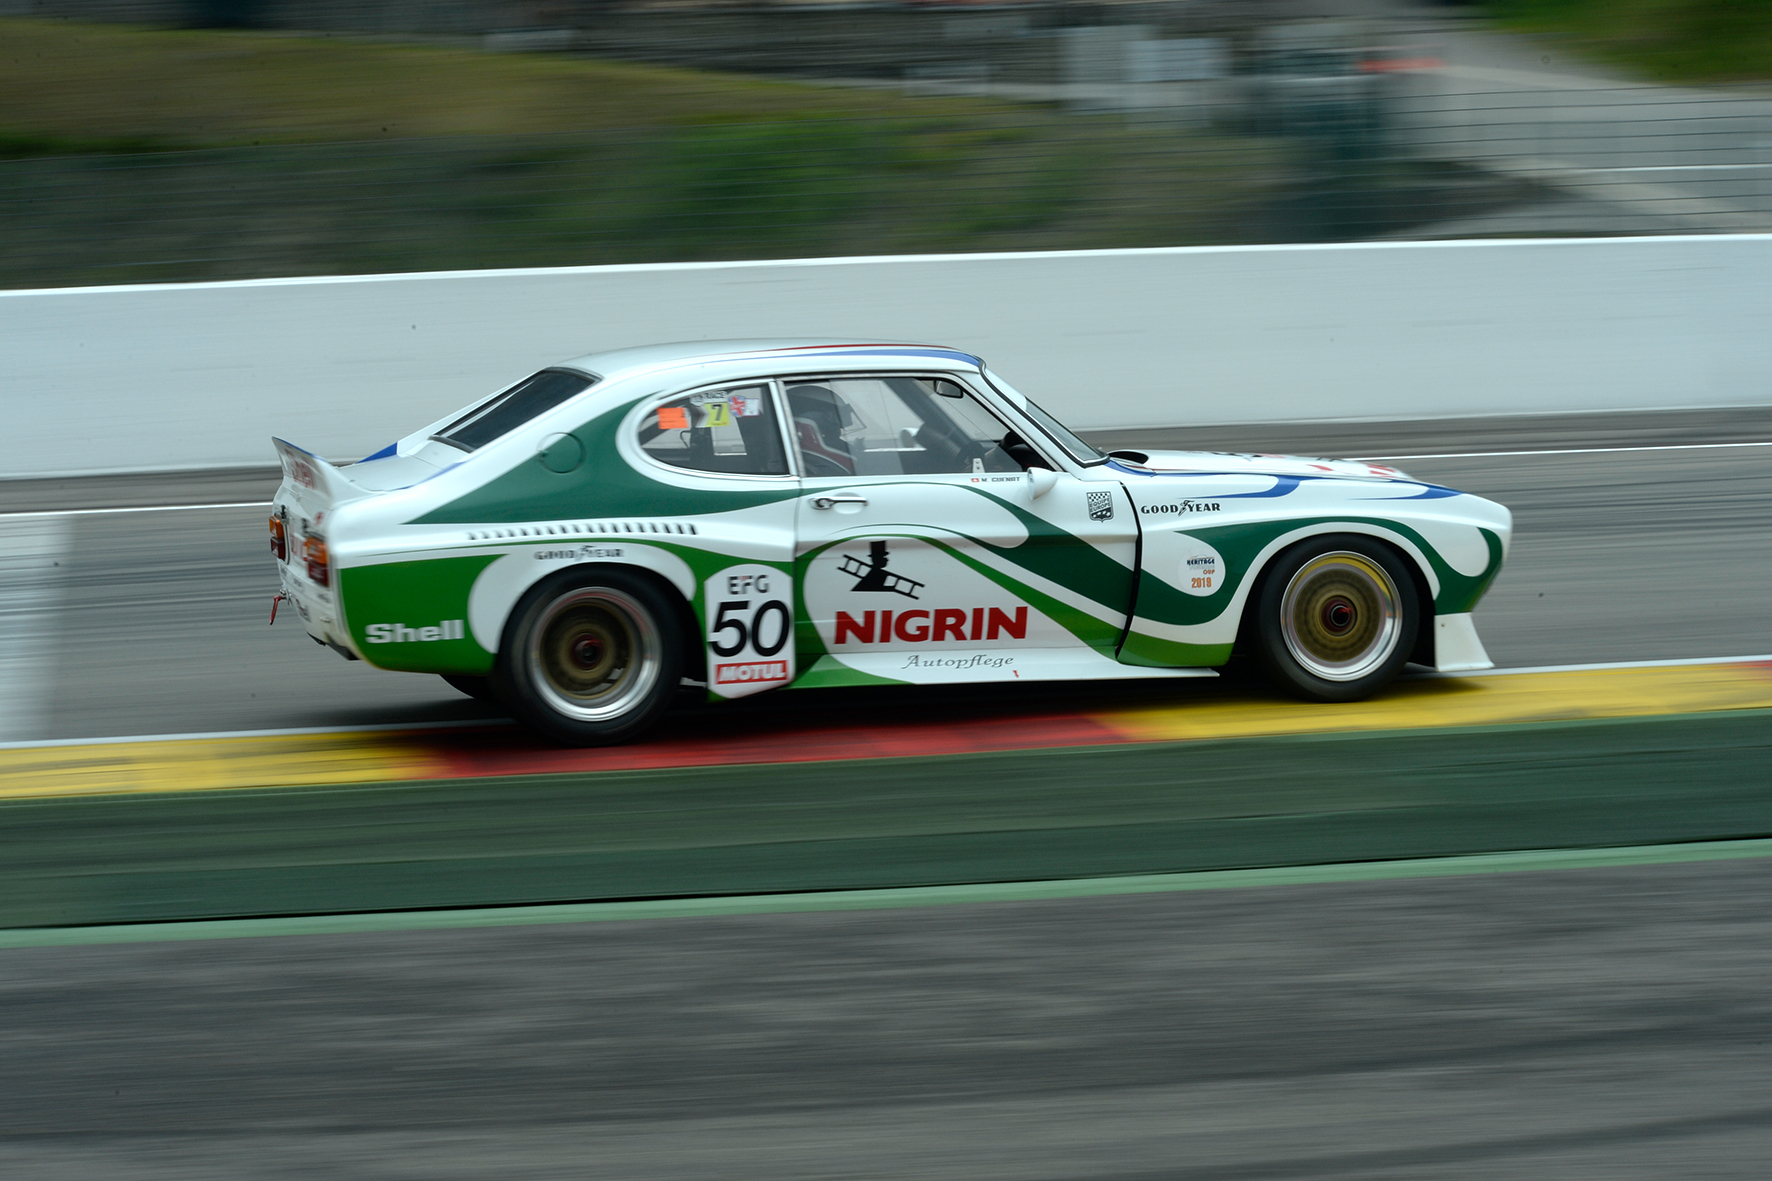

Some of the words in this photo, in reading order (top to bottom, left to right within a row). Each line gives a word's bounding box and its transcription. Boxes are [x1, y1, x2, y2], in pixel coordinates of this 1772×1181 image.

[712, 404, 722, 421] 7
[1186, 558, 1215, 566] HERITAGE
[728, 574, 769, 595] EFG
[1191, 577, 1212, 588] 2019
[365, 619, 464, 643] Shell
[710, 600, 790, 657] 50
[834, 606, 1028, 645] NIGRIN
[901, 654, 1014, 669] Autopflege
[717, 663, 785, 682] MOTUL
